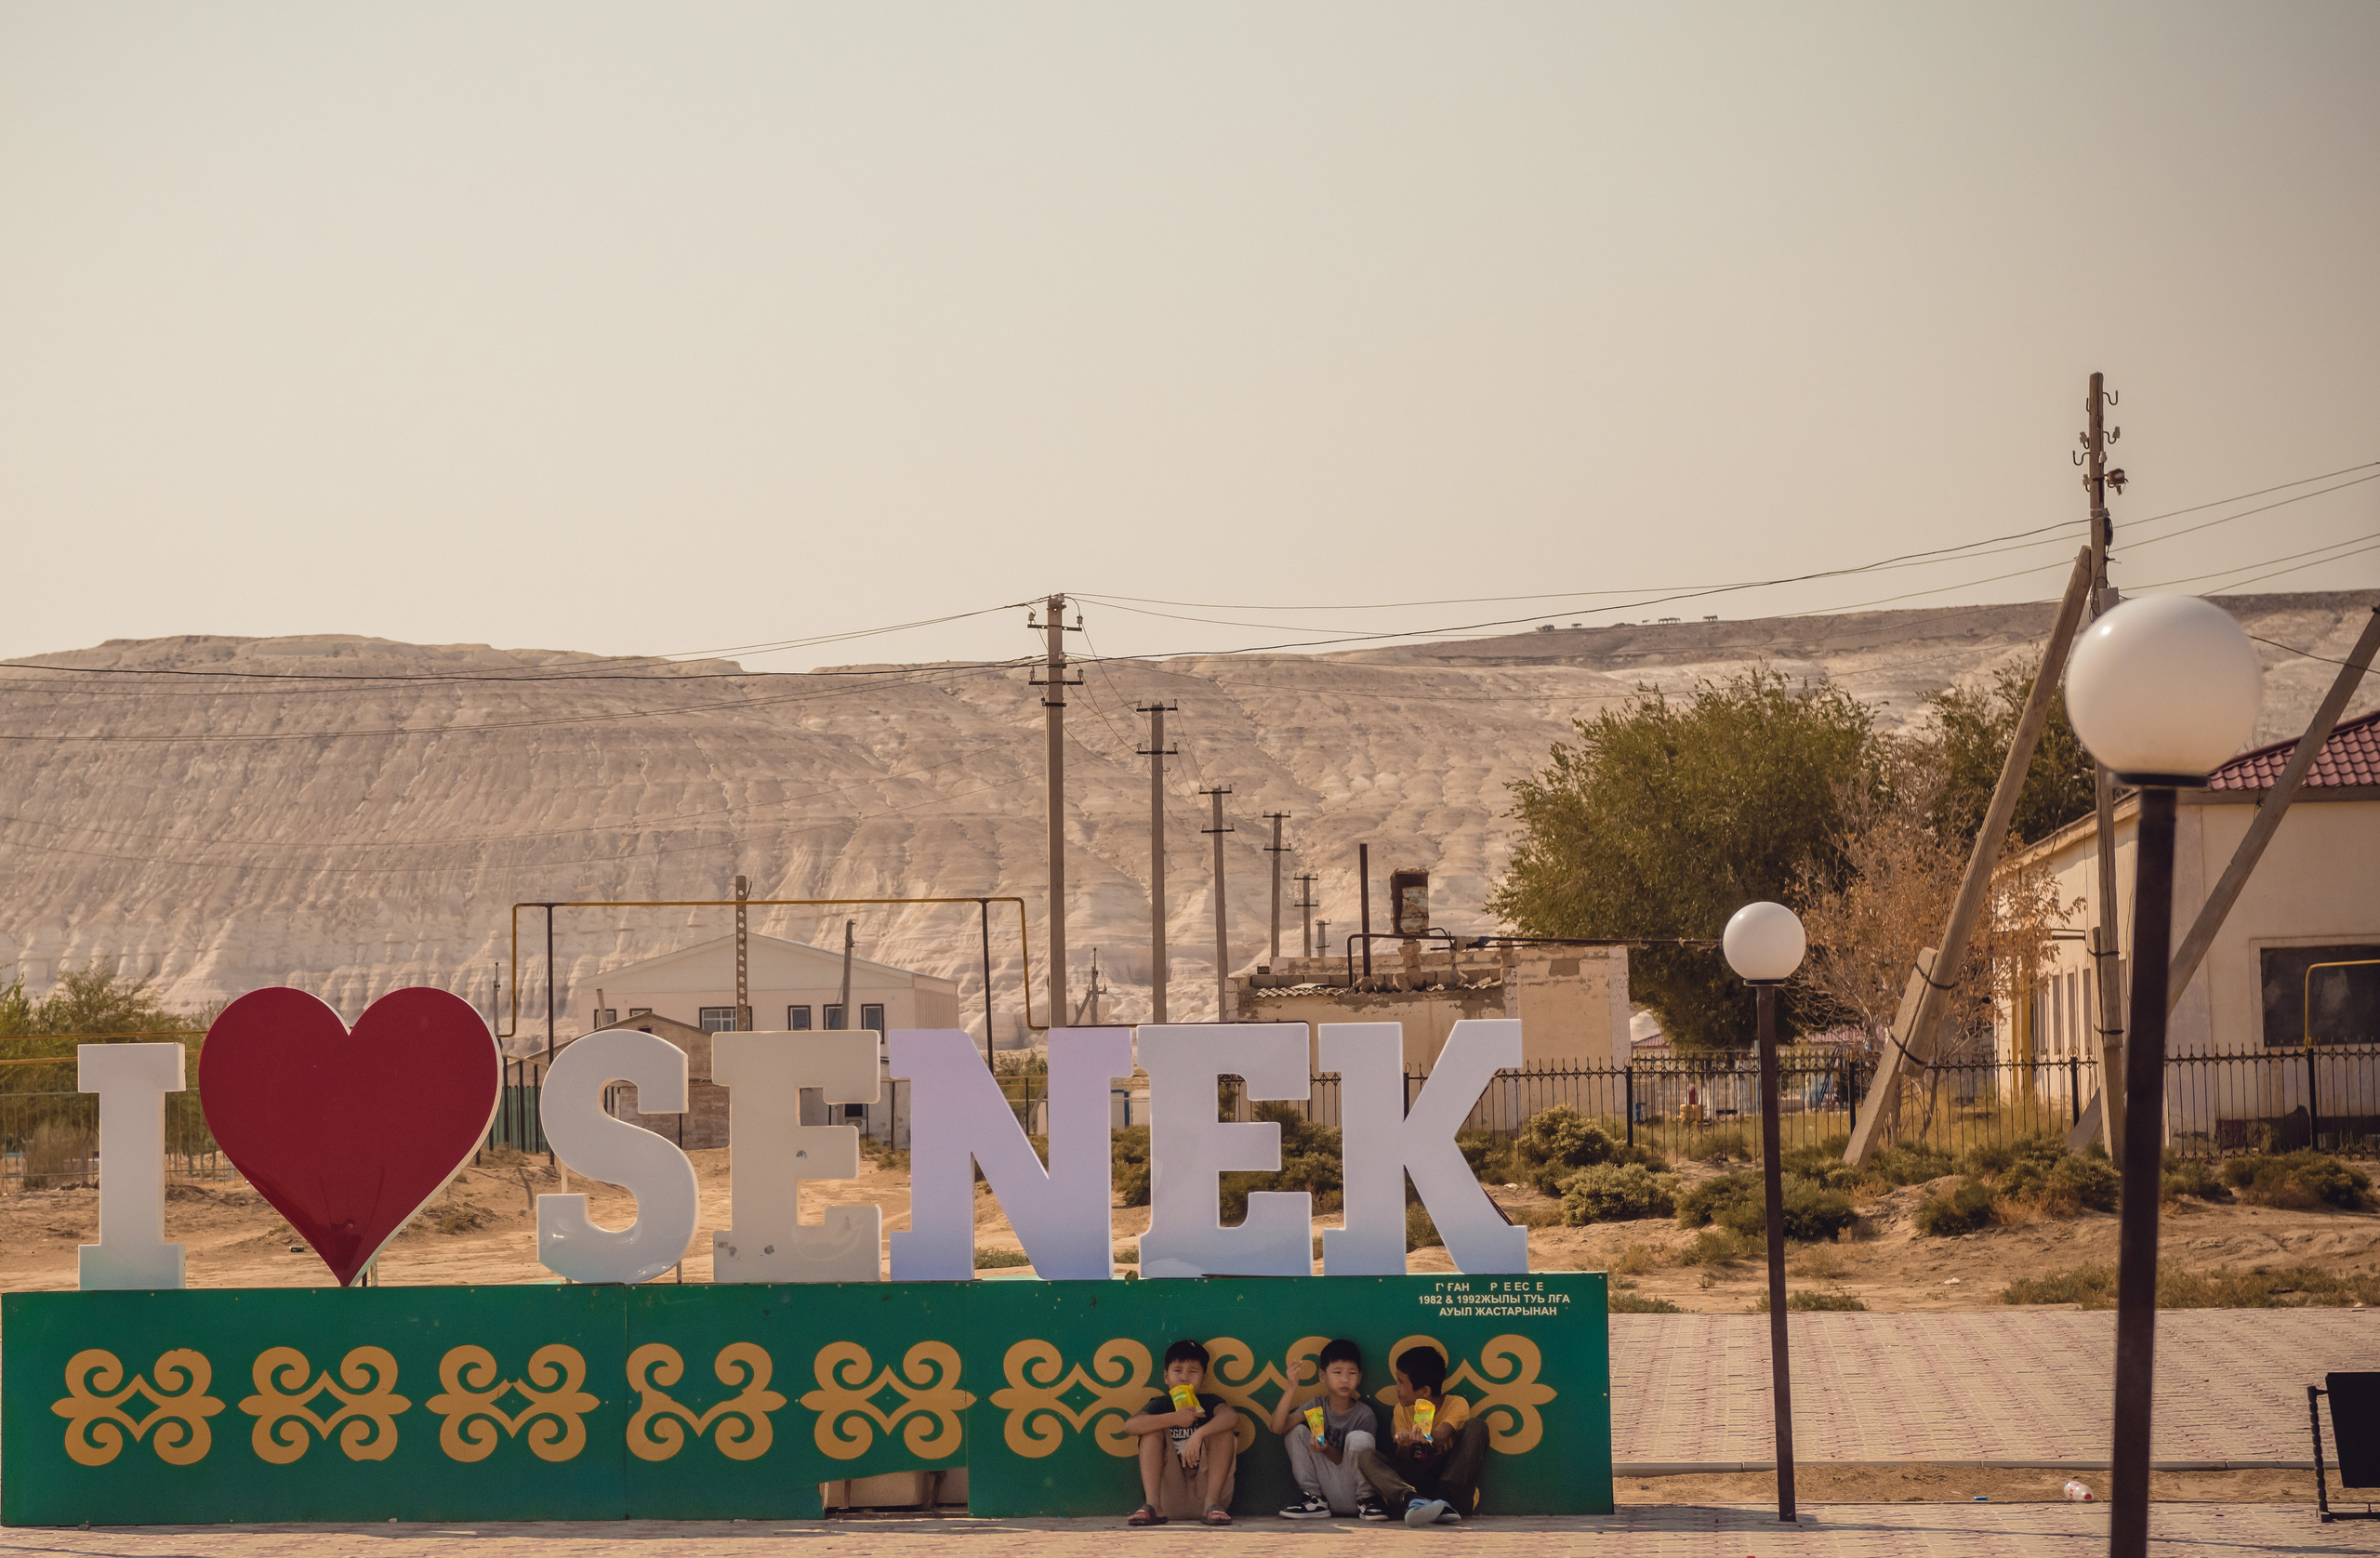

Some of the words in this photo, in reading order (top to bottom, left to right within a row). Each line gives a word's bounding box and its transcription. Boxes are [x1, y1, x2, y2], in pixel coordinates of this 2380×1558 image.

[77, 1043, 186, 1289] I
[536, 1020, 1528, 1284] SENEK
[1418, 1295, 1443, 1304] 1982
[1445, 1295, 1453, 1304] &
[1439, 1307, 1473, 1316] АУЫЛ
[1474, 1306, 1557, 1316] ЖАСТАРЫНАН
